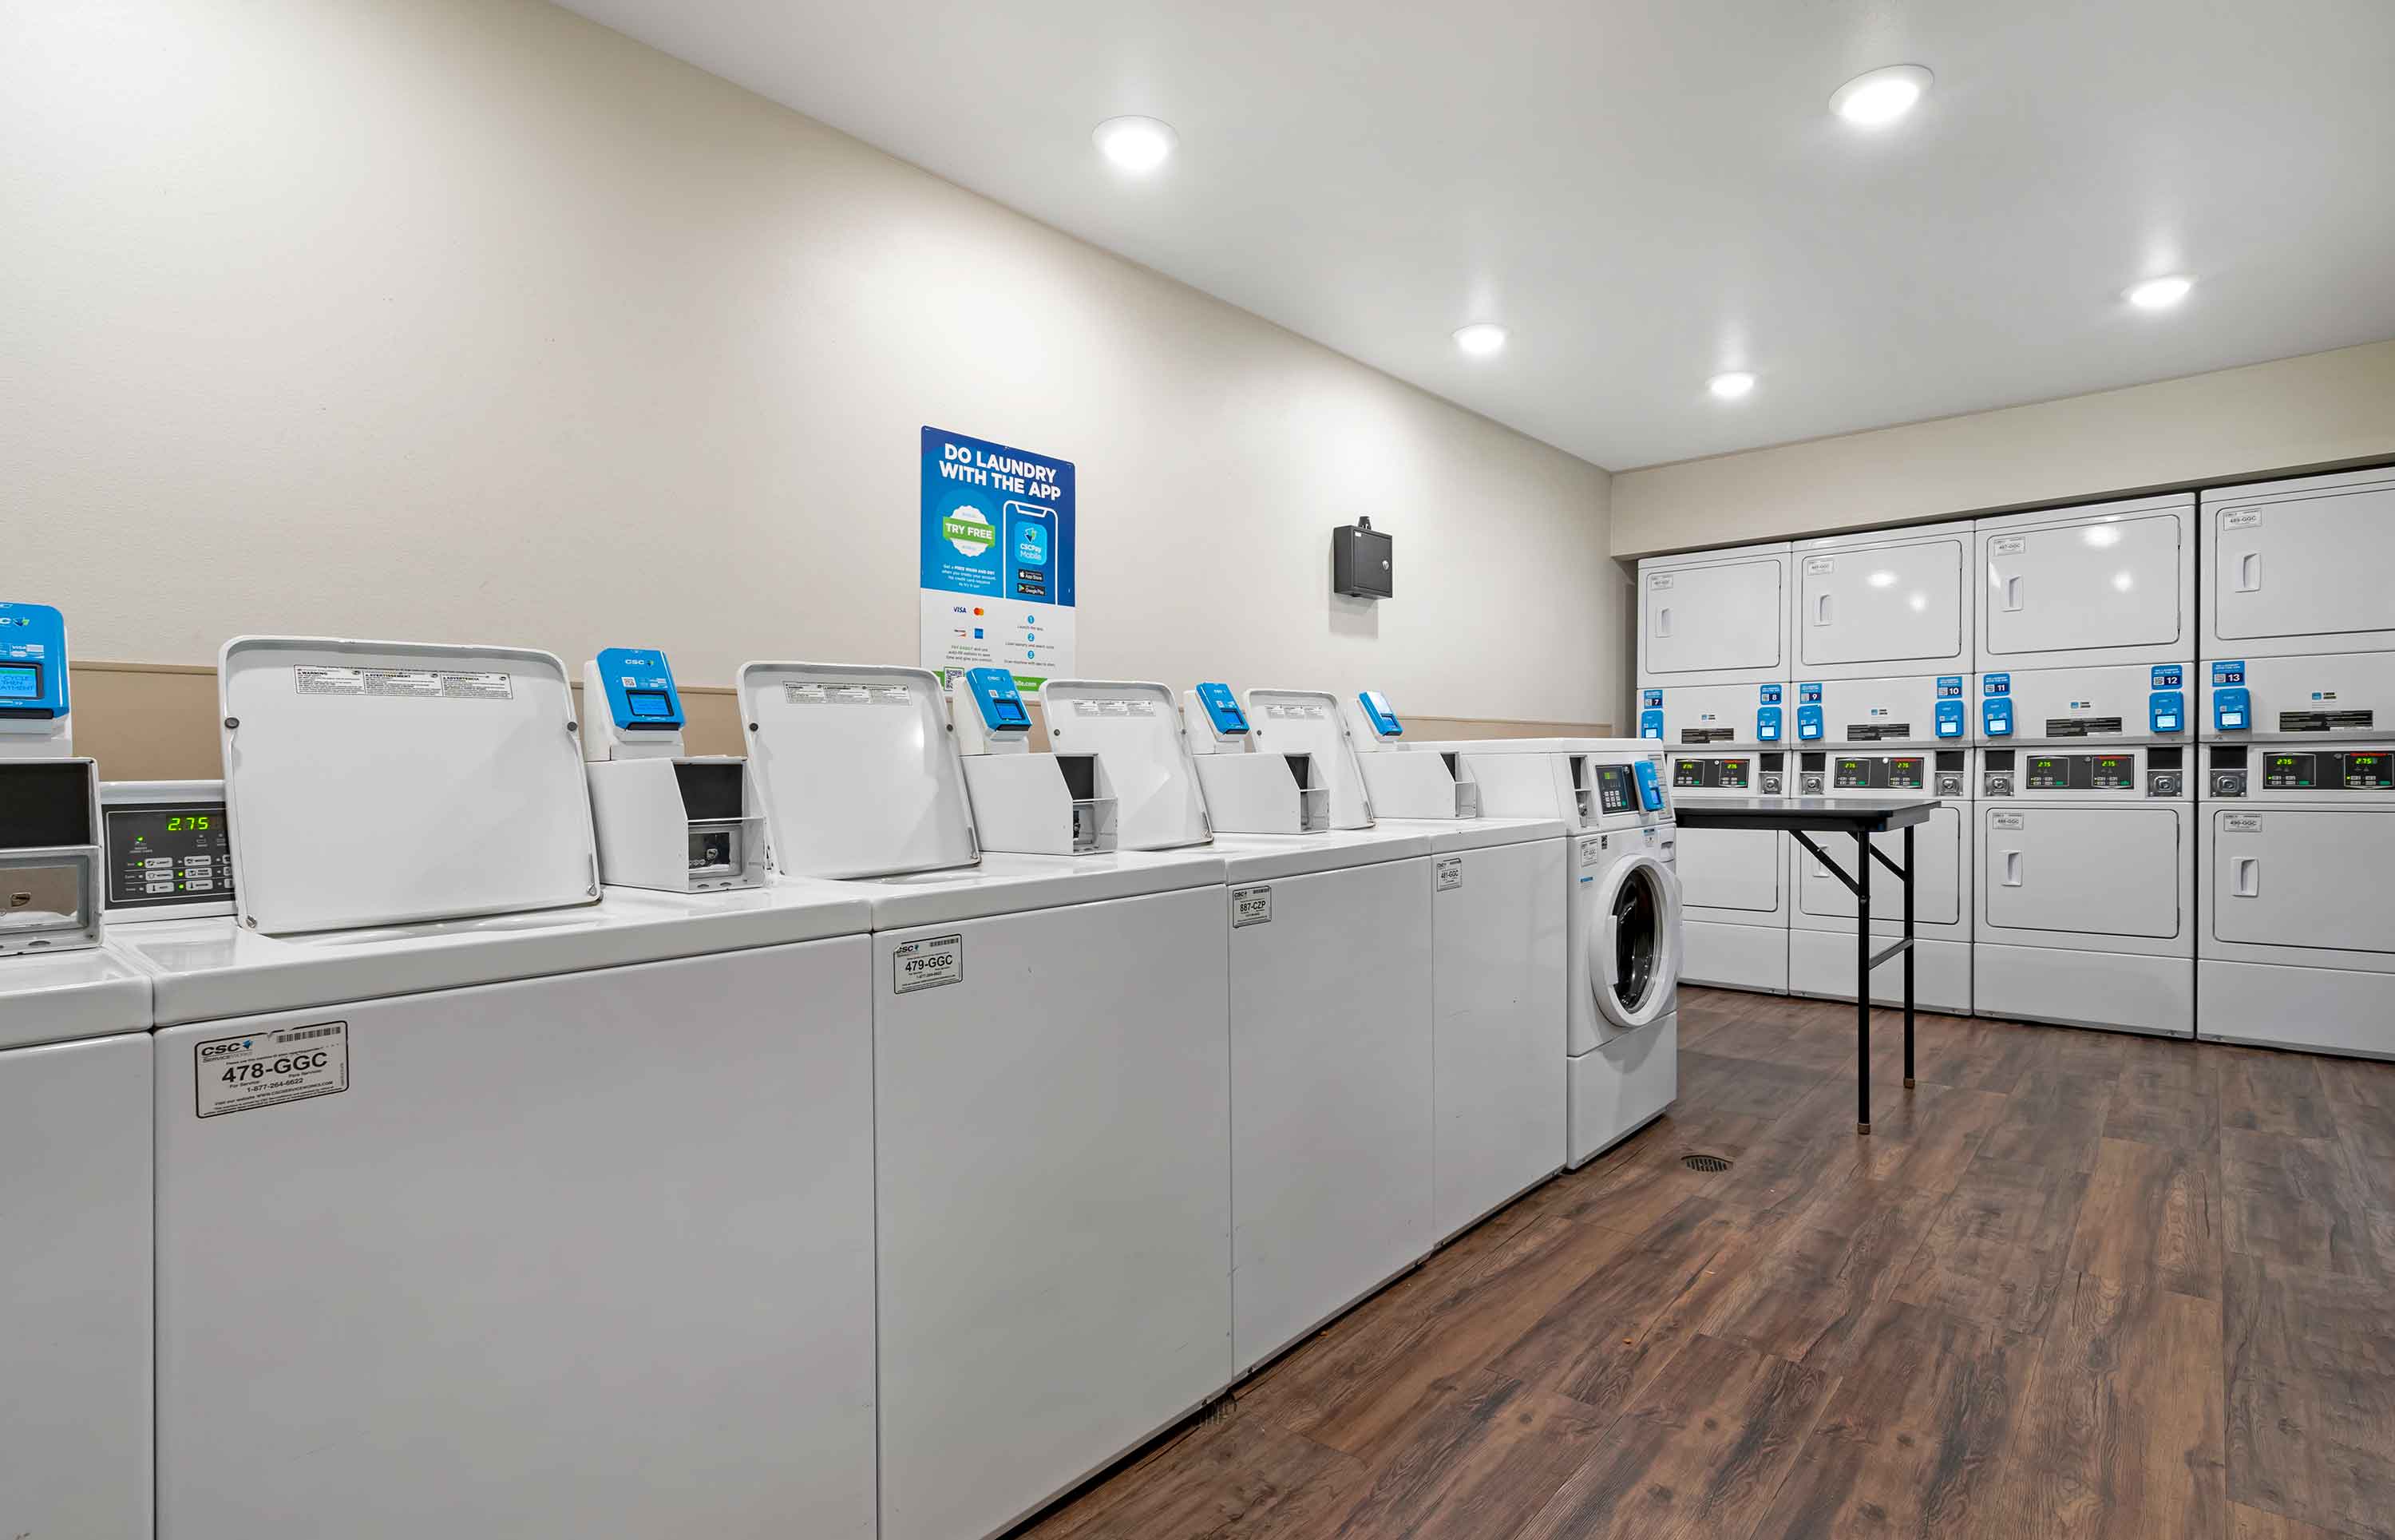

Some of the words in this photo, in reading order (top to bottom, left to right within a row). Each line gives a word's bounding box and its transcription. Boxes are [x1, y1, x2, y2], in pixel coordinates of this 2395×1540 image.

[944, 443, 972, 464] DO
[977, 450, 1057, 483] LAUNDRY
[939, 460, 987, 486] WITH
[991, 473, 1025, 494] THE
[1028, 483, 1061, 501] APP
[945, 523, 965, 535] TRY
[968, 527, 993, 540] FREE
[168, 817, 208, 831] 2.75
[1240, 901, 1266, 912] 887-CZP
[905, 954, 953, 972] 479-GGC
[201, 1043, 240, 1056] CSC
[222, 1051, 327, 1083] 478-GGC
